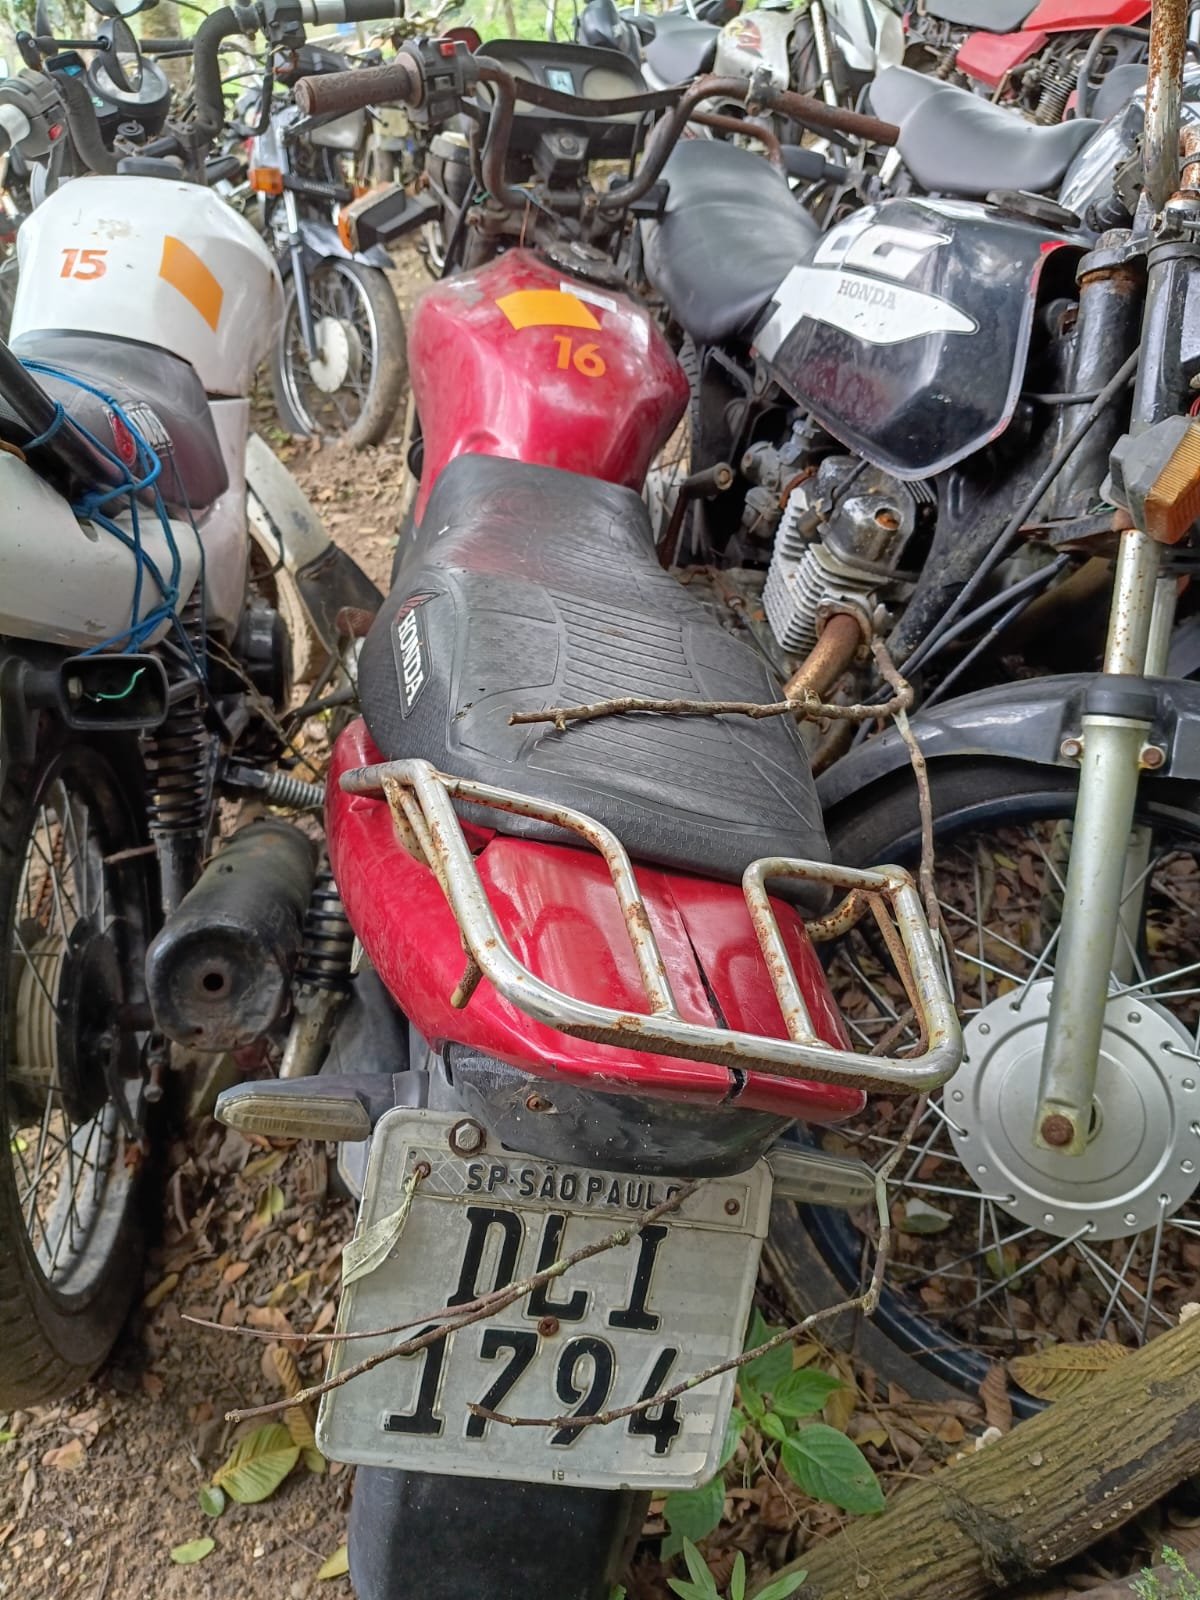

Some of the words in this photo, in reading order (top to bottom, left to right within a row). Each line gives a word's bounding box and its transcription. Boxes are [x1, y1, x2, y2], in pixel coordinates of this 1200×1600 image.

[60, 248, 108, 280] 15
[837, 279, 897, 310] HONDA
[552, 335, 606, 377] 16
[398, 608, 424, 706] HONDA
[447, 1207, 668, 1330] DLI
[384, 1325, 682, 1454] 1794
